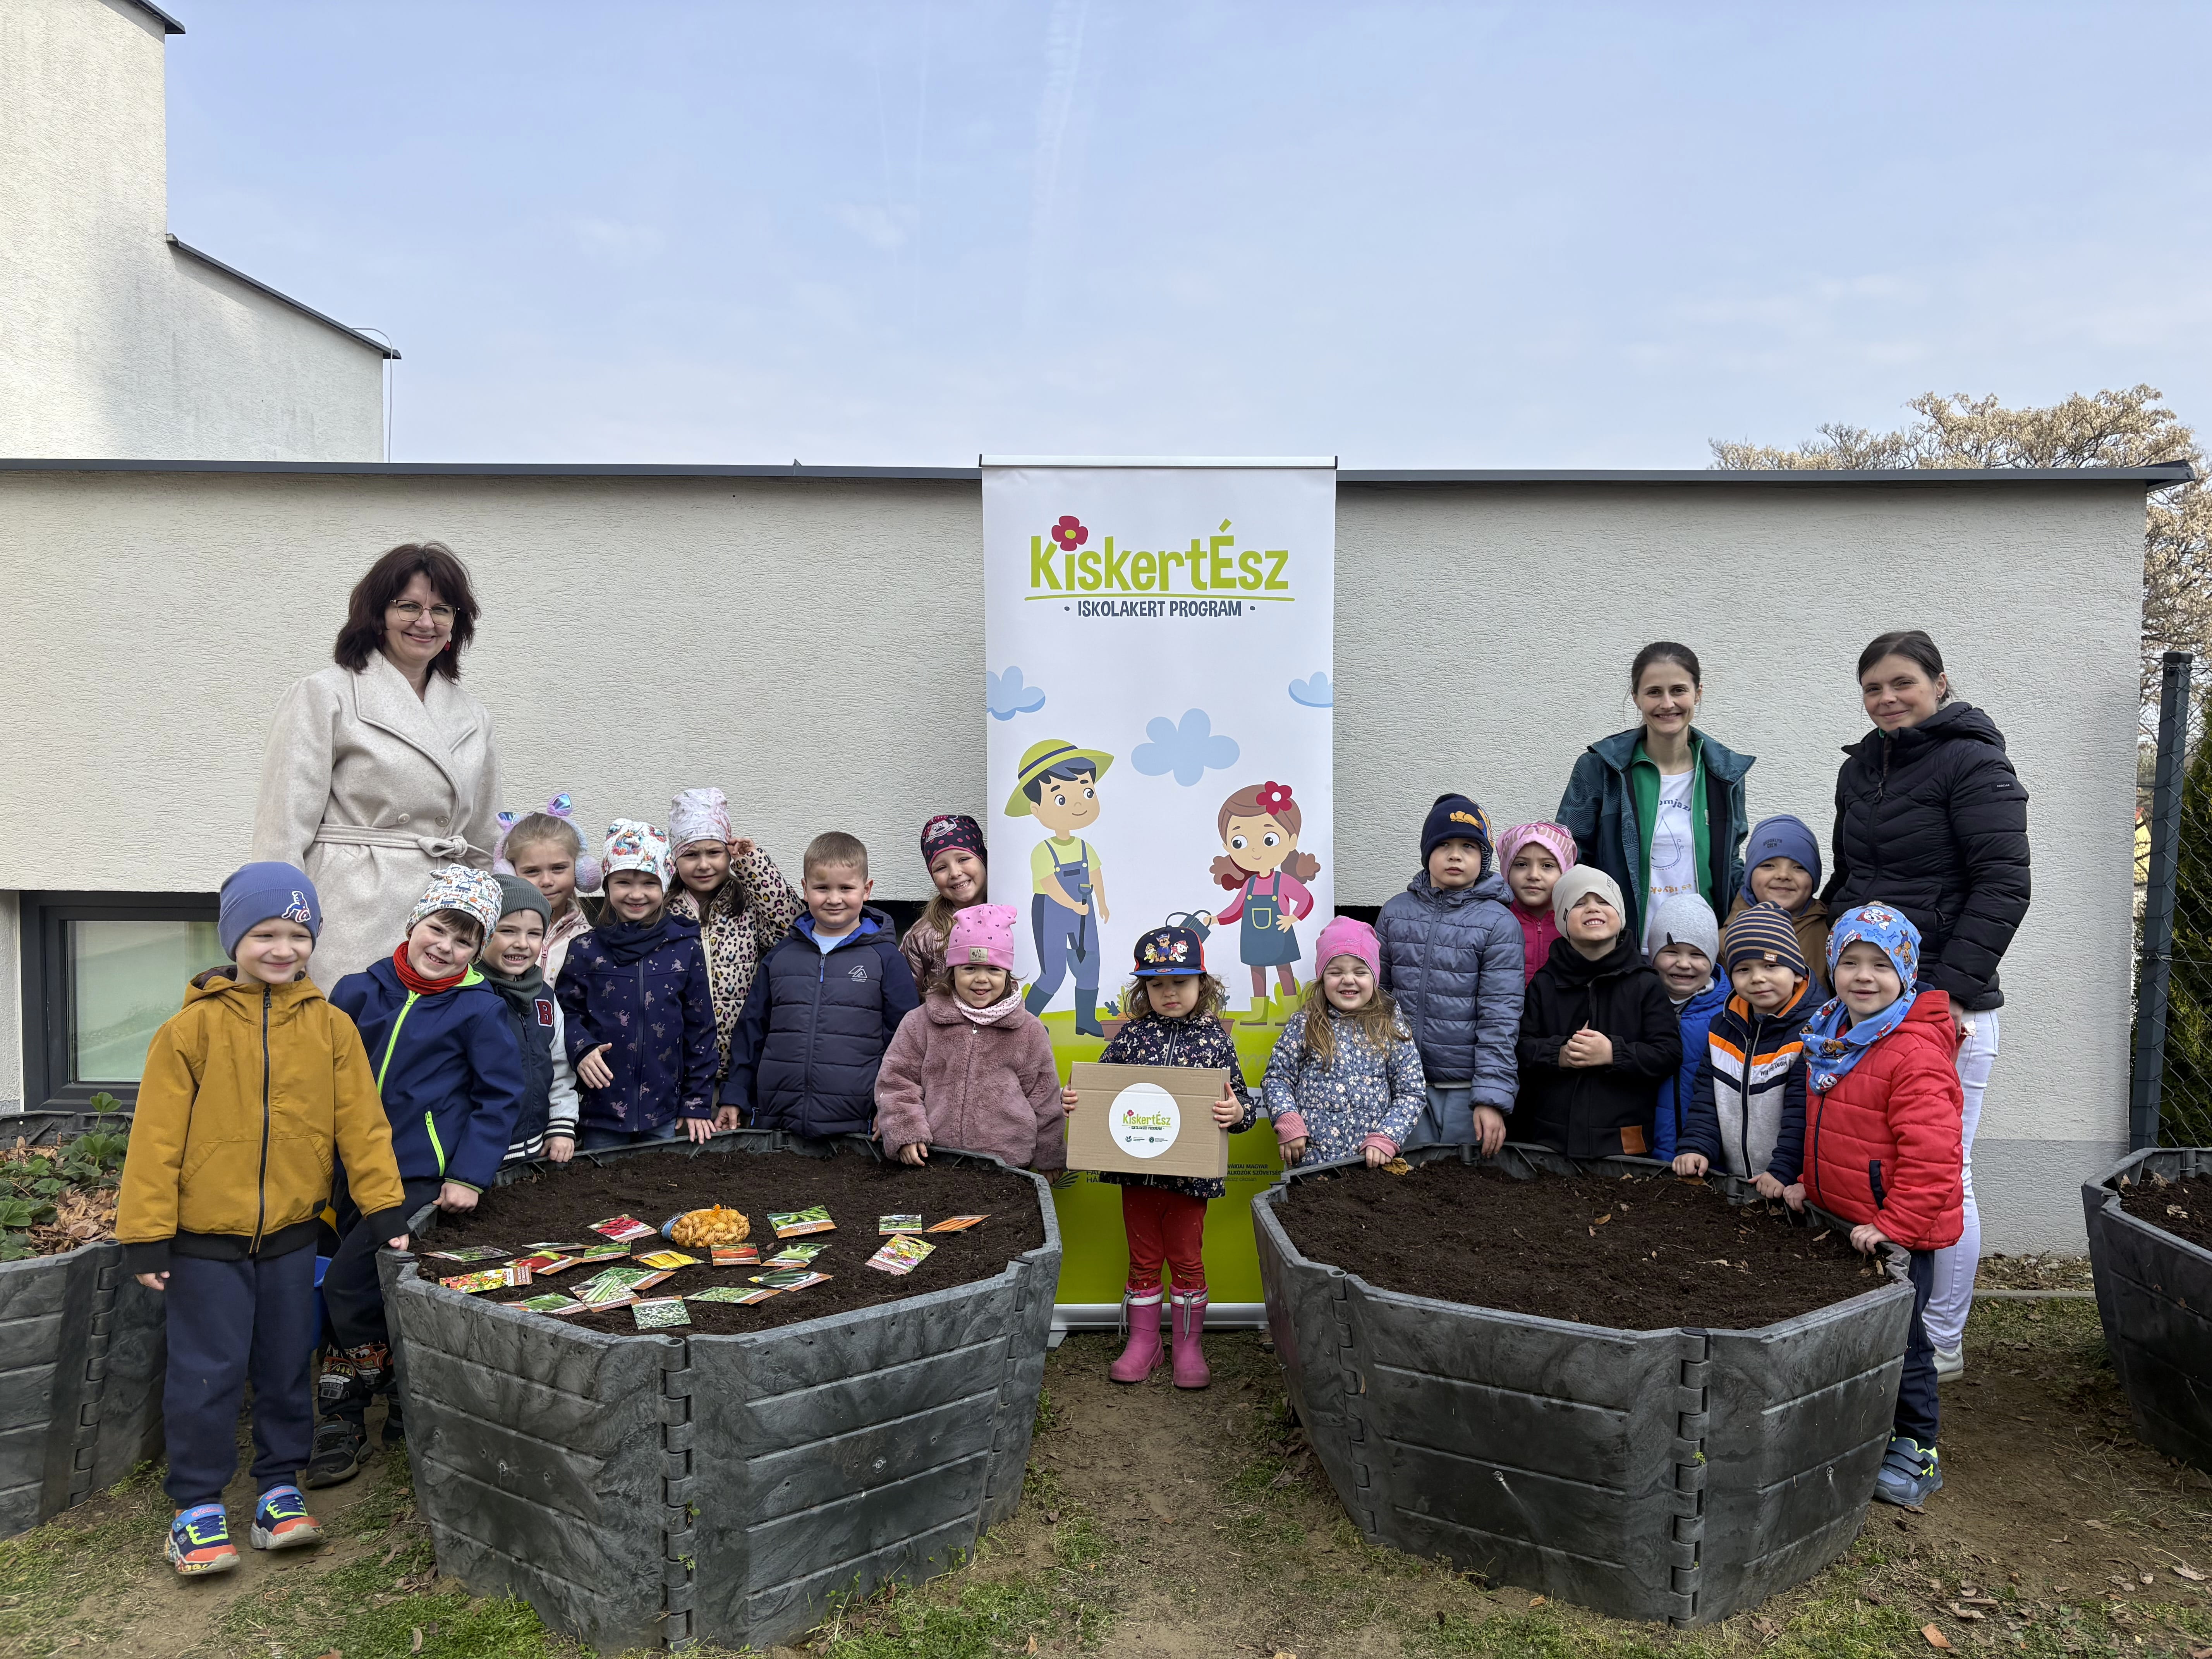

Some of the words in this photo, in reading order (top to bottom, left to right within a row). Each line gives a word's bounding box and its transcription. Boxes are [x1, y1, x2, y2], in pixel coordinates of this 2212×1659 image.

[1030, 518, 1289, 591] KiskertÉsz
[1078, 600, 1166, 617] ISKOLAKERT
[1170, 600, 1242, 618] PROGRAM
[535, 999, 553, 1027] B
